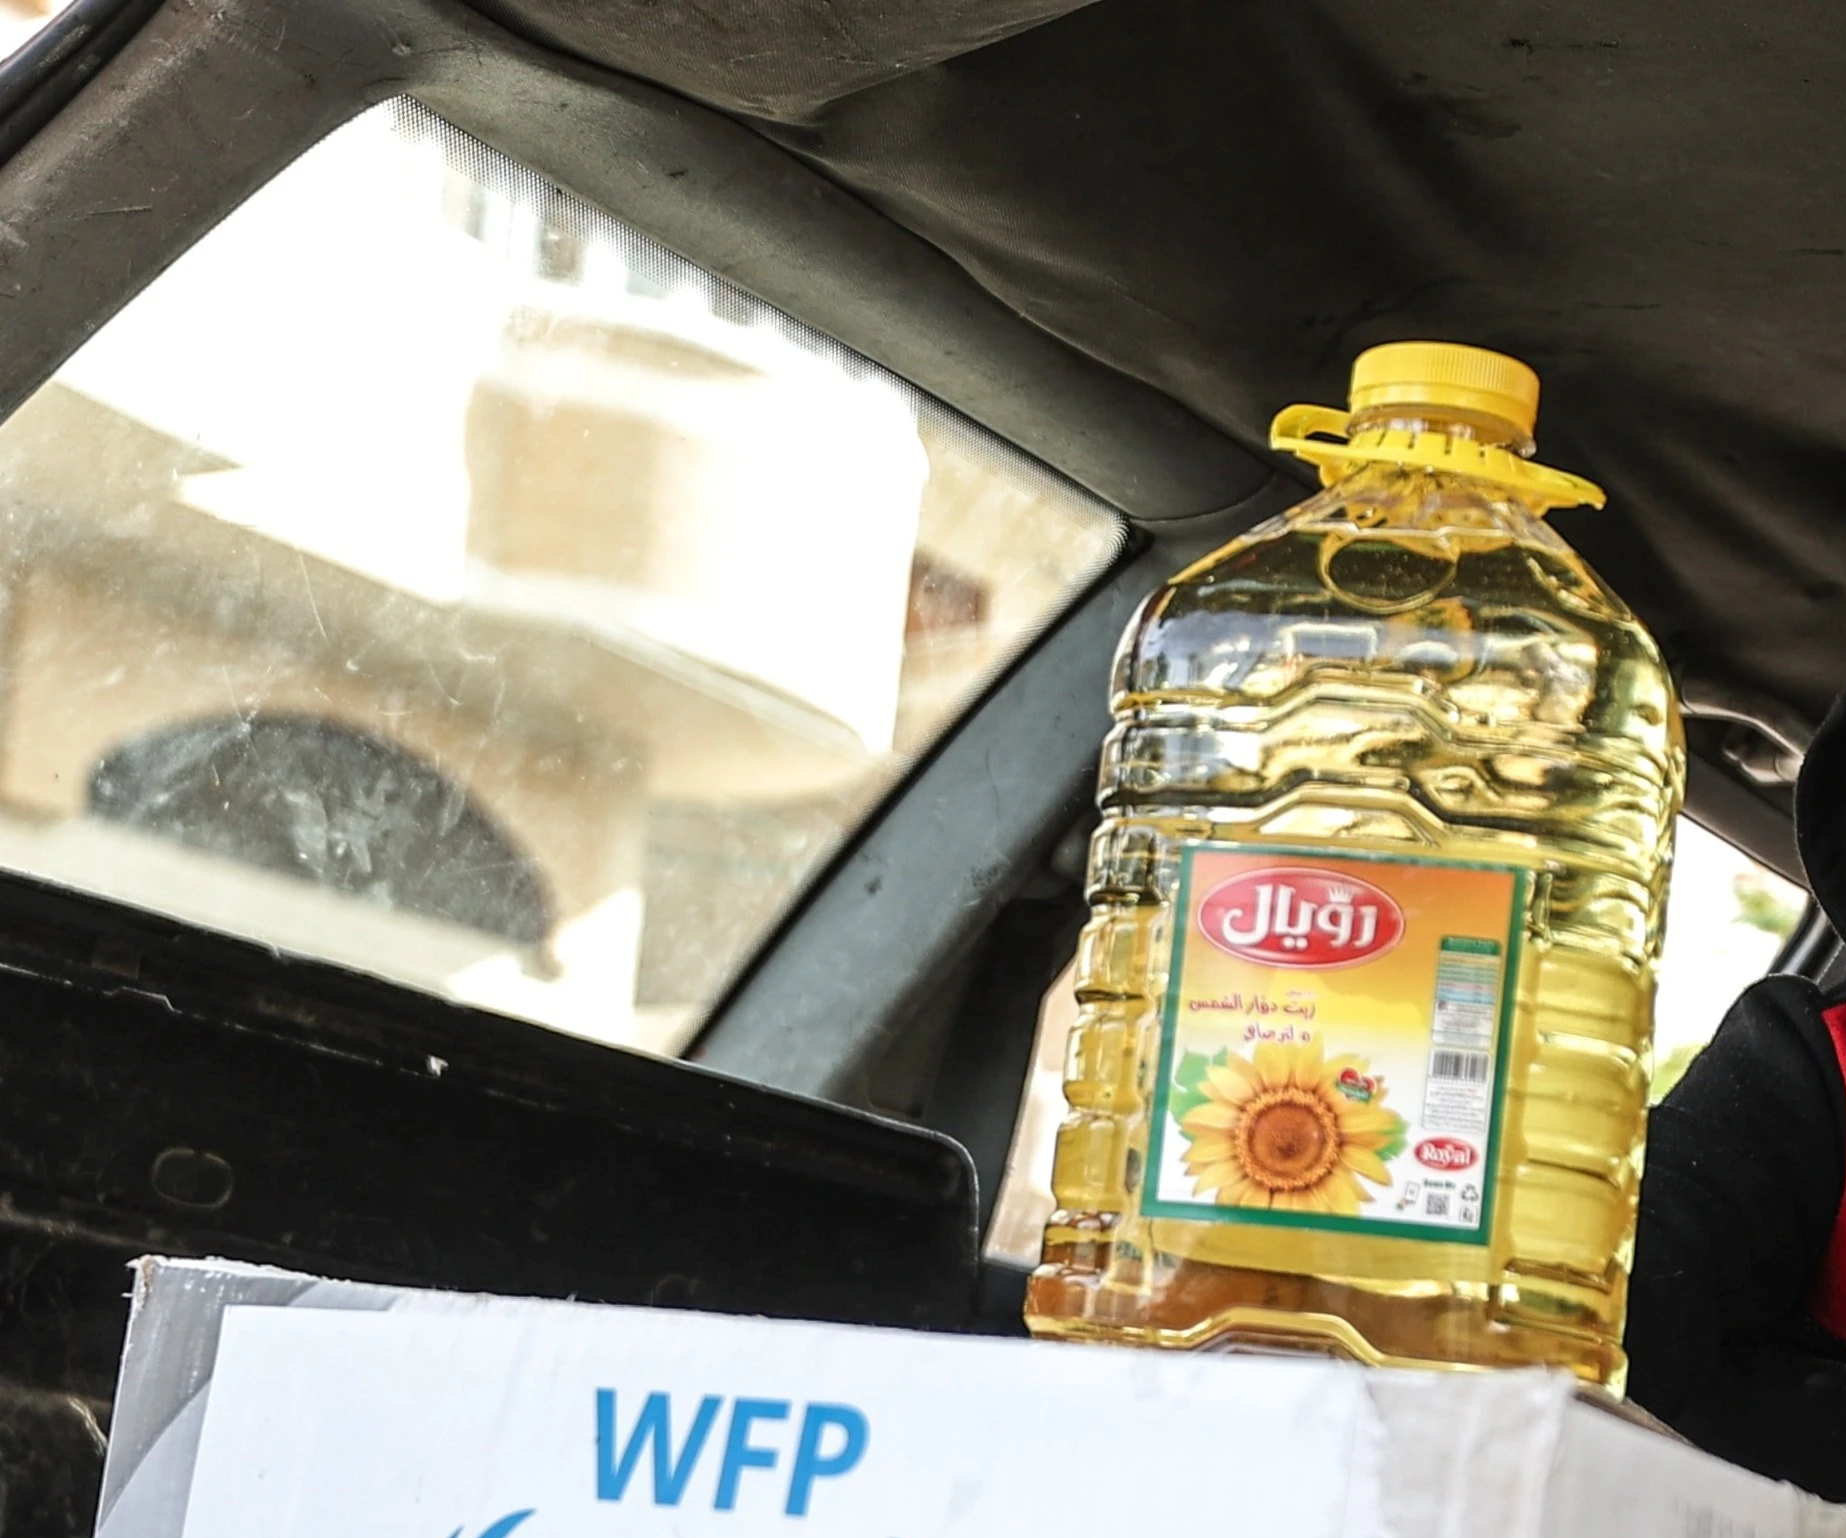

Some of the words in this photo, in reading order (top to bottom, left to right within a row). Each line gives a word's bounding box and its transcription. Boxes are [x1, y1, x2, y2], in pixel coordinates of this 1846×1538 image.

[1222, 882, 1378, 949] رويال
[1420, 1142, 1471, 1166] Royal
[595, 1387, 871, 1519] WFP
